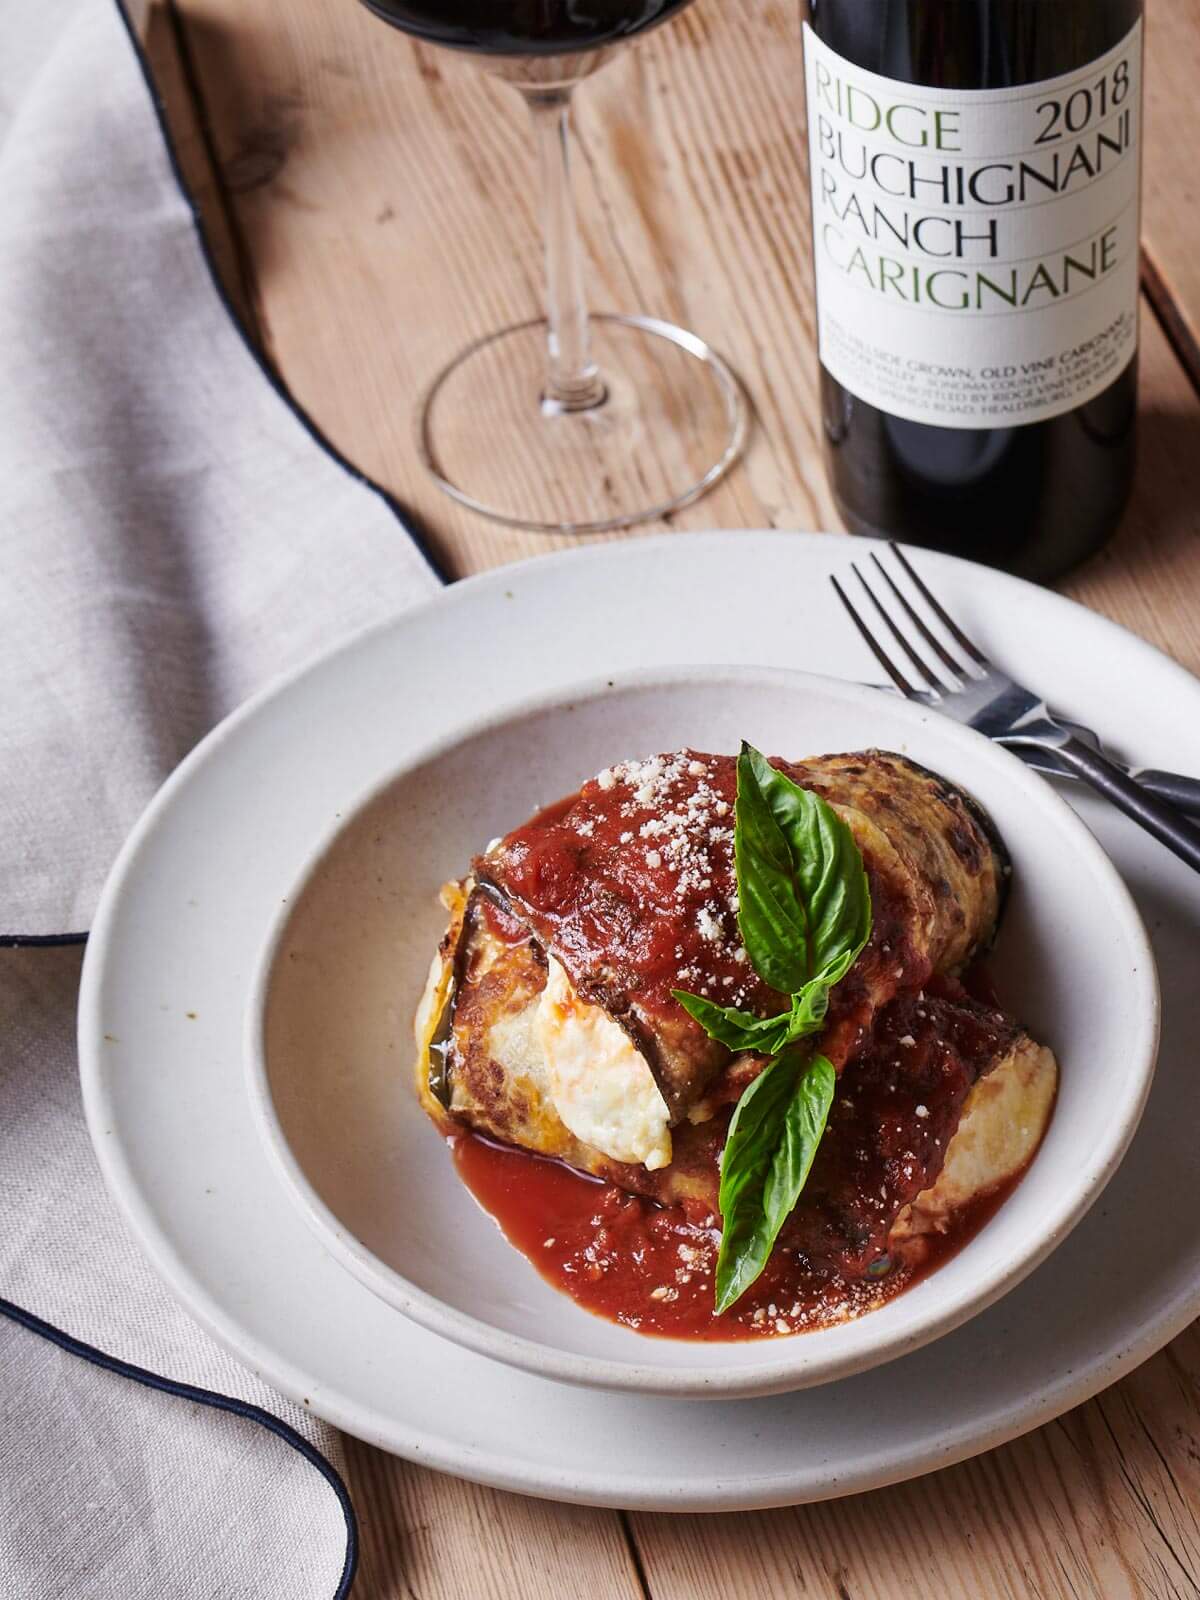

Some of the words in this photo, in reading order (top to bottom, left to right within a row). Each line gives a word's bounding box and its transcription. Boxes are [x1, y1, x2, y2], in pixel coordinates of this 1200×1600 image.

[815, 60, 962, 151] RIDGE
[1034, 59, 1129, 145] 2018
[818, 109, 1129, 206] BUCHIGNANI
[820, 167, 998, 258] RANCH
[823, 223, 1118, 310] CARIGNANE
[979, 365, 1017, 380] OLD
[1020, 356, 1056, 375] VINE
